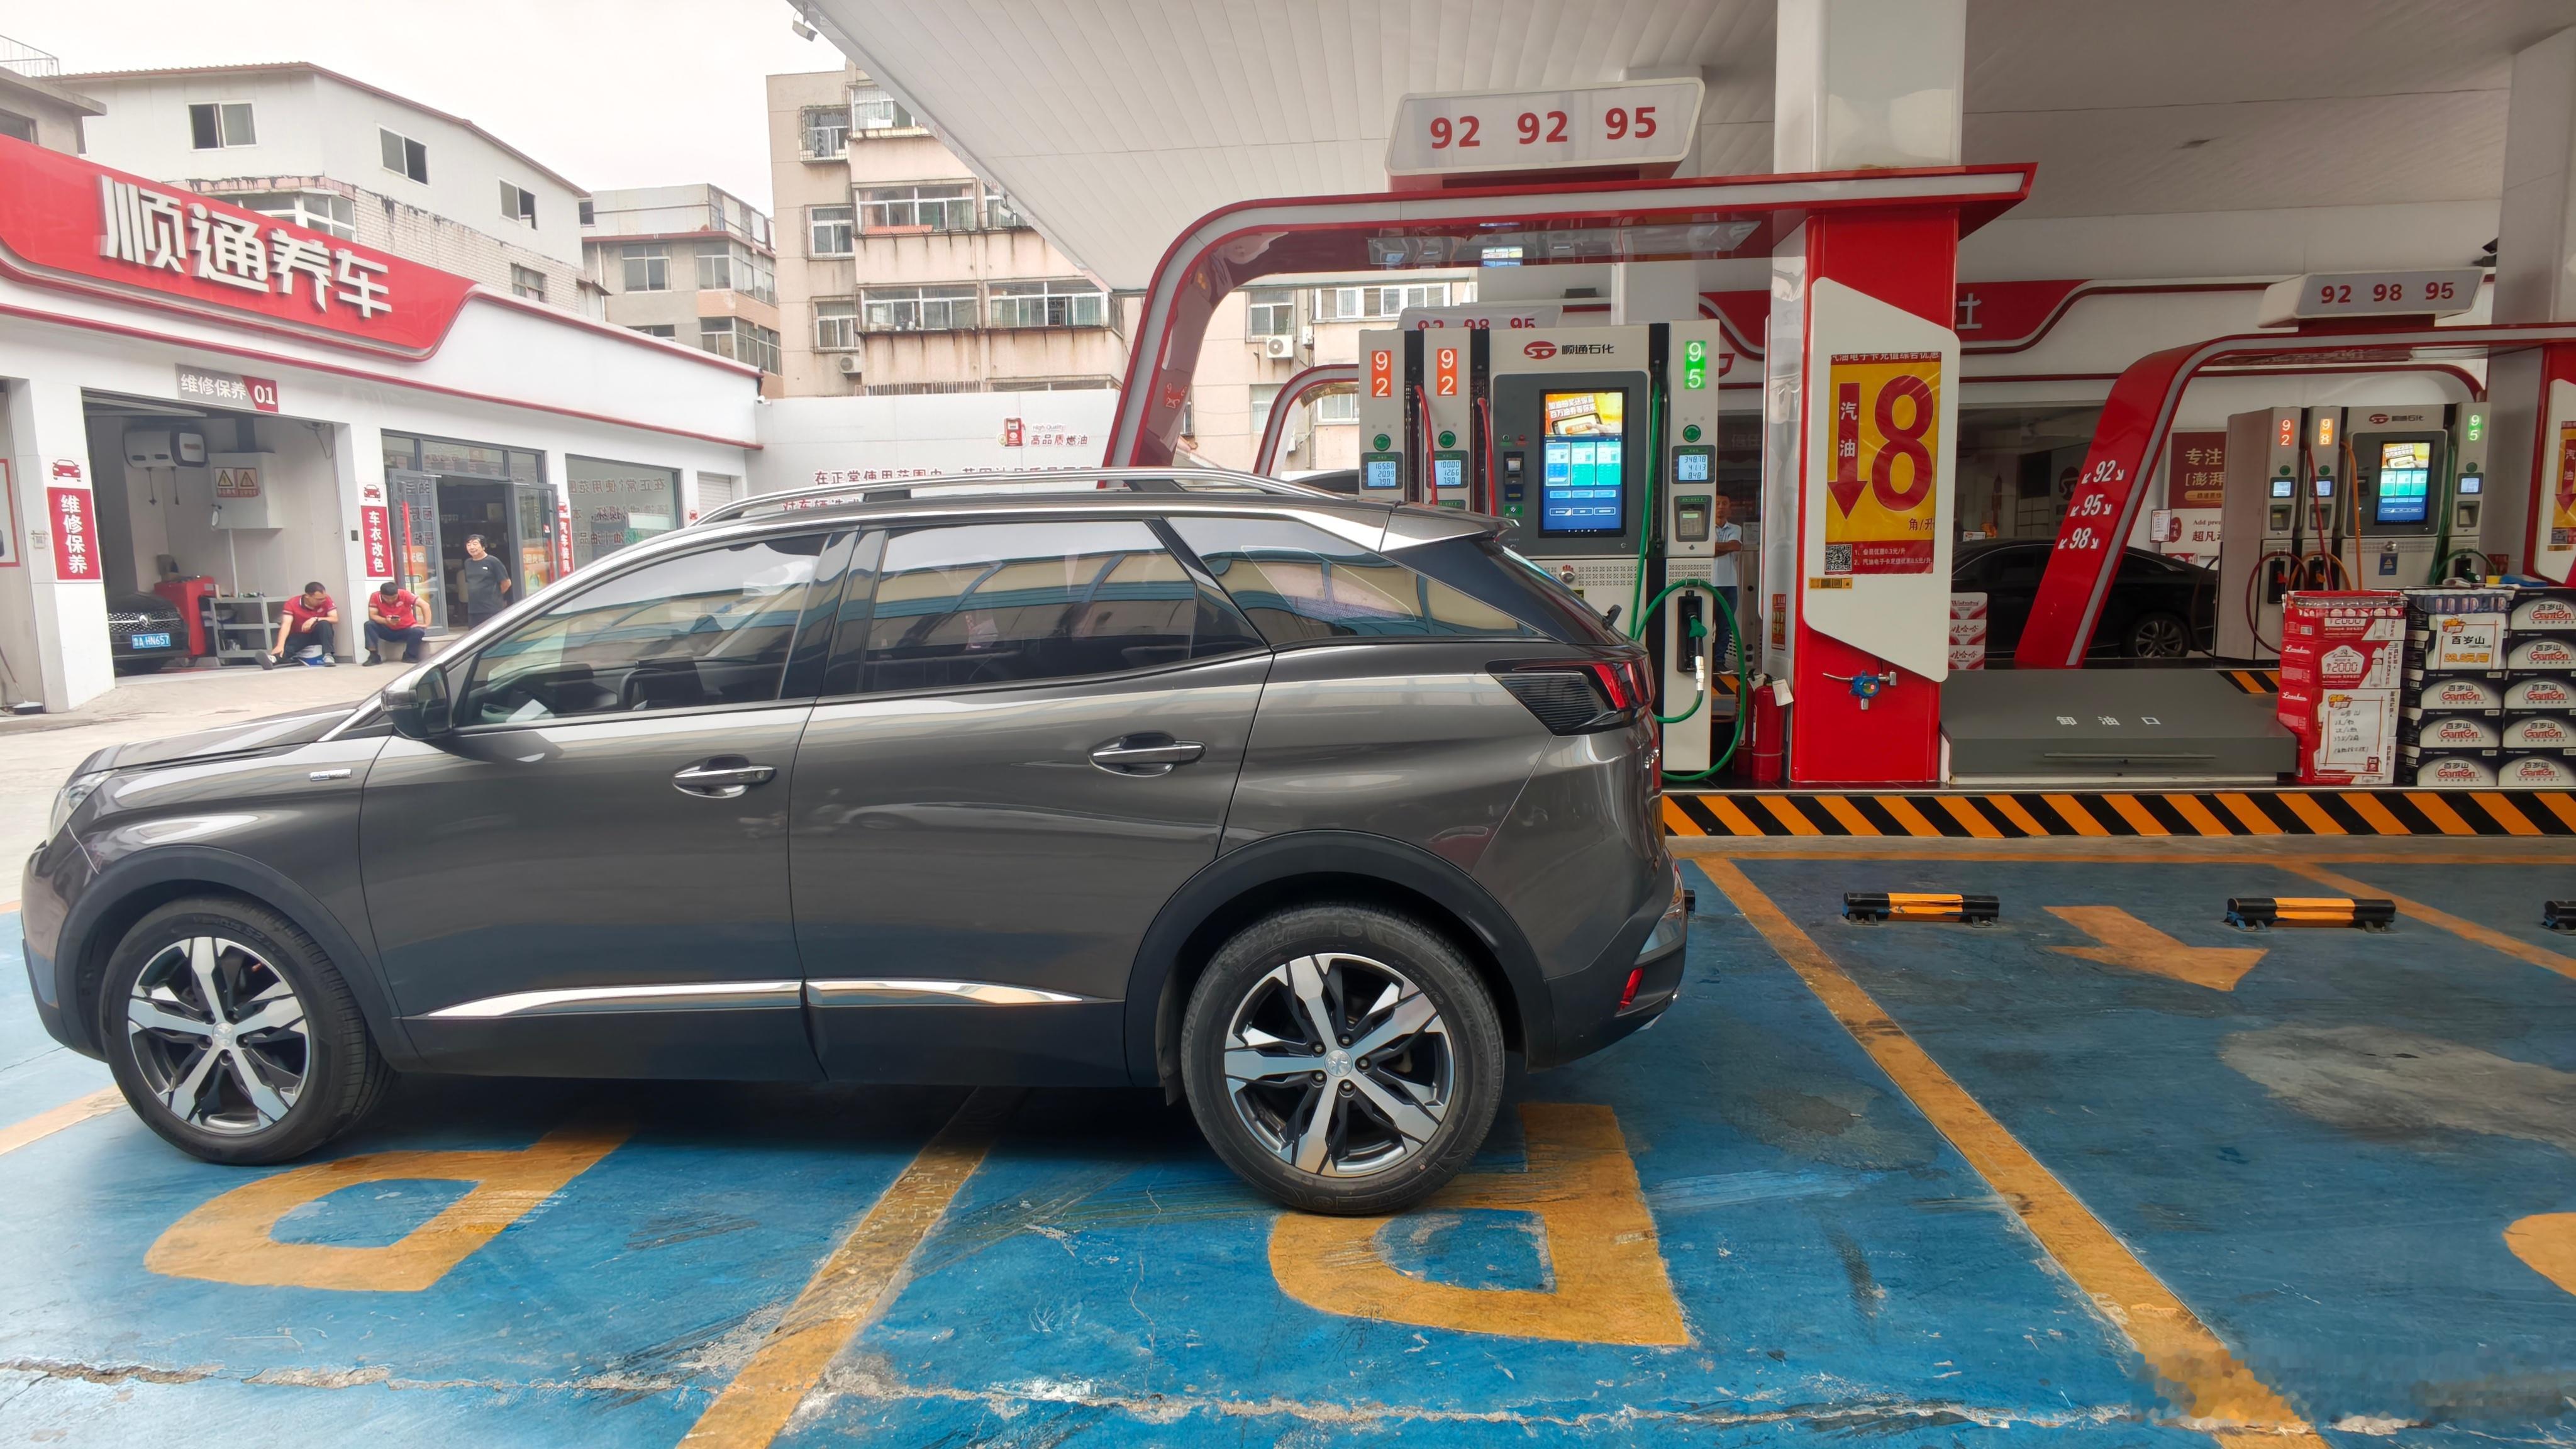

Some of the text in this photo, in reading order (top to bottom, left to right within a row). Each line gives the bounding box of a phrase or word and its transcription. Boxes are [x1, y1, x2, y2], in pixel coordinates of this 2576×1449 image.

[1430, 106, 1657, 149] 92 92 95
[99, 174, 392, 318] 顺通养车
[2321, 282, 2454, 303] 92 98 95
[1562, 344, 1614, 355] 顺通石化
[1375, 352, 1388, 396] 92
[1441, 350, 1454, 395] 92
[1689, 342, 1702, 389] 95
[181, 374, 275, 404] 维修保养 01
[1031, 434, 1088, 446] 高品质燃油
[1840, 402, 1857, 457] 汽油
[2281, 419, 2291, 445] 92
[2320, 419, 2331, 445] 98
[2470, 414, 2480, 441] 95
[1872, 375, 1934, 512] 8
[2185, 448, 2222, 465] 专注
[2093, 460, 2116, 482] 92
[2081, 494, 2104, 516] 95
[60, 494, 87, 574] 维修保养
[369, 511, 385, 573] 车衣改色
[2069, 527, 2092, 549] 98
[2451, 636, 2485, 645] 百岁山
[2057, 716, 2161, 726] 卸油口
